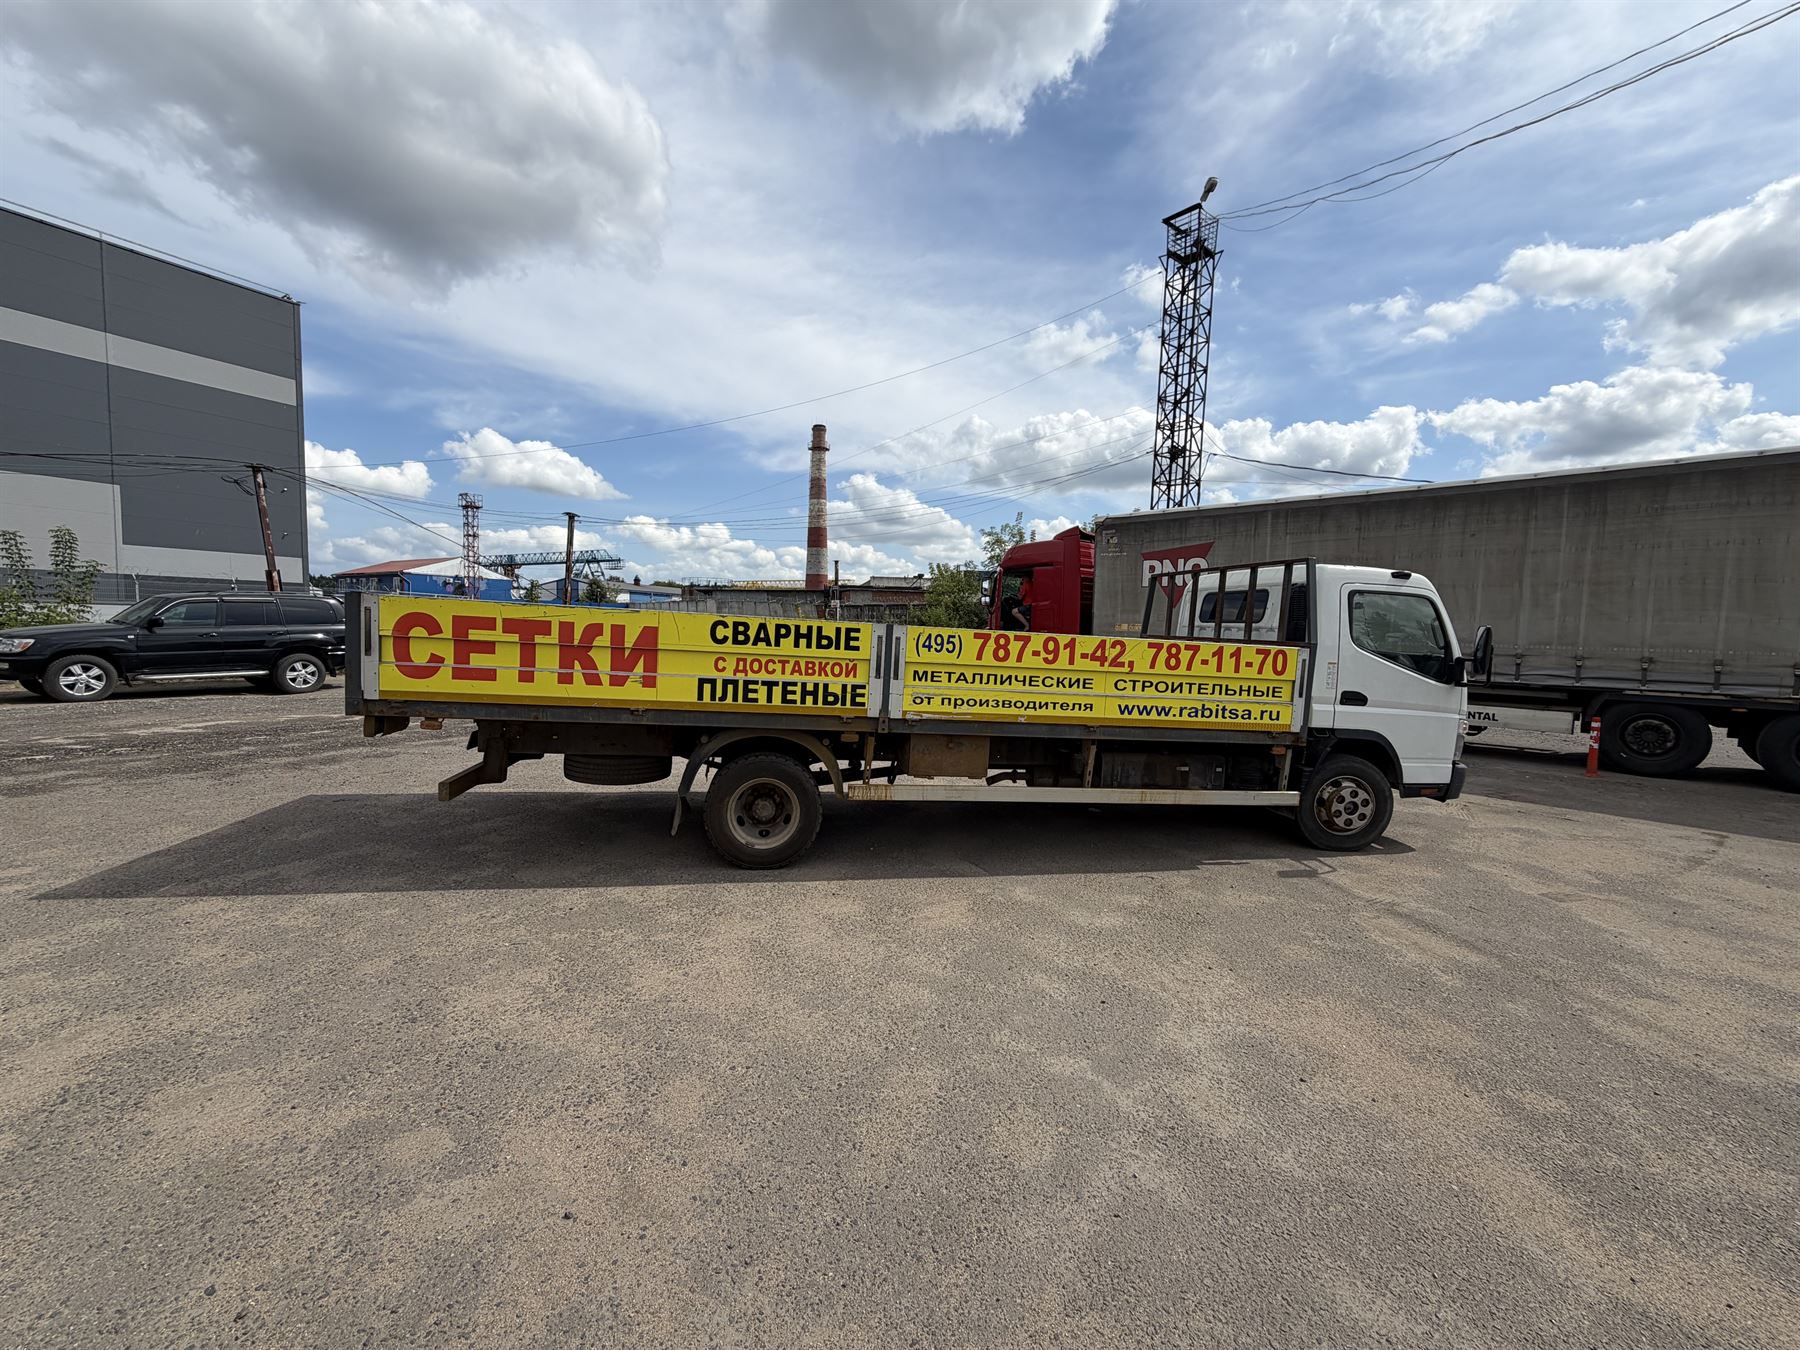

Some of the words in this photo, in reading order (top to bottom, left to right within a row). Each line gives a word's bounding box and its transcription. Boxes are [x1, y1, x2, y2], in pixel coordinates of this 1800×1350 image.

[709, 619, 861, 652] СВАРНЫЕ
[391, 611, 659, 688] СЕТКИ
[915, 632, 963, 659] (495)
[973, 632, 1135, 673] 787-91-42,
[1147, 642, 1288, 676] 787-11-70
[713, 656, 728, 673] С
[732, 657, 858, 679] ДОСТАВКОЙ
[912, 670, 1095, 690] МЕТАЛЛИЧЕСКИЕ
[1113, 678, 1283, 699] СТРОИТЕЛЬНЫЕ
[697, 677, 867, 708] ПЛЕТЕНЫЕ
[912, 695, 935, 706] от
[940, 696, 1094, 712] производителя
[1117, 703, 1281, 722] www.rabitsa.ru
[1466, 711, 1499, 722] NTAL
